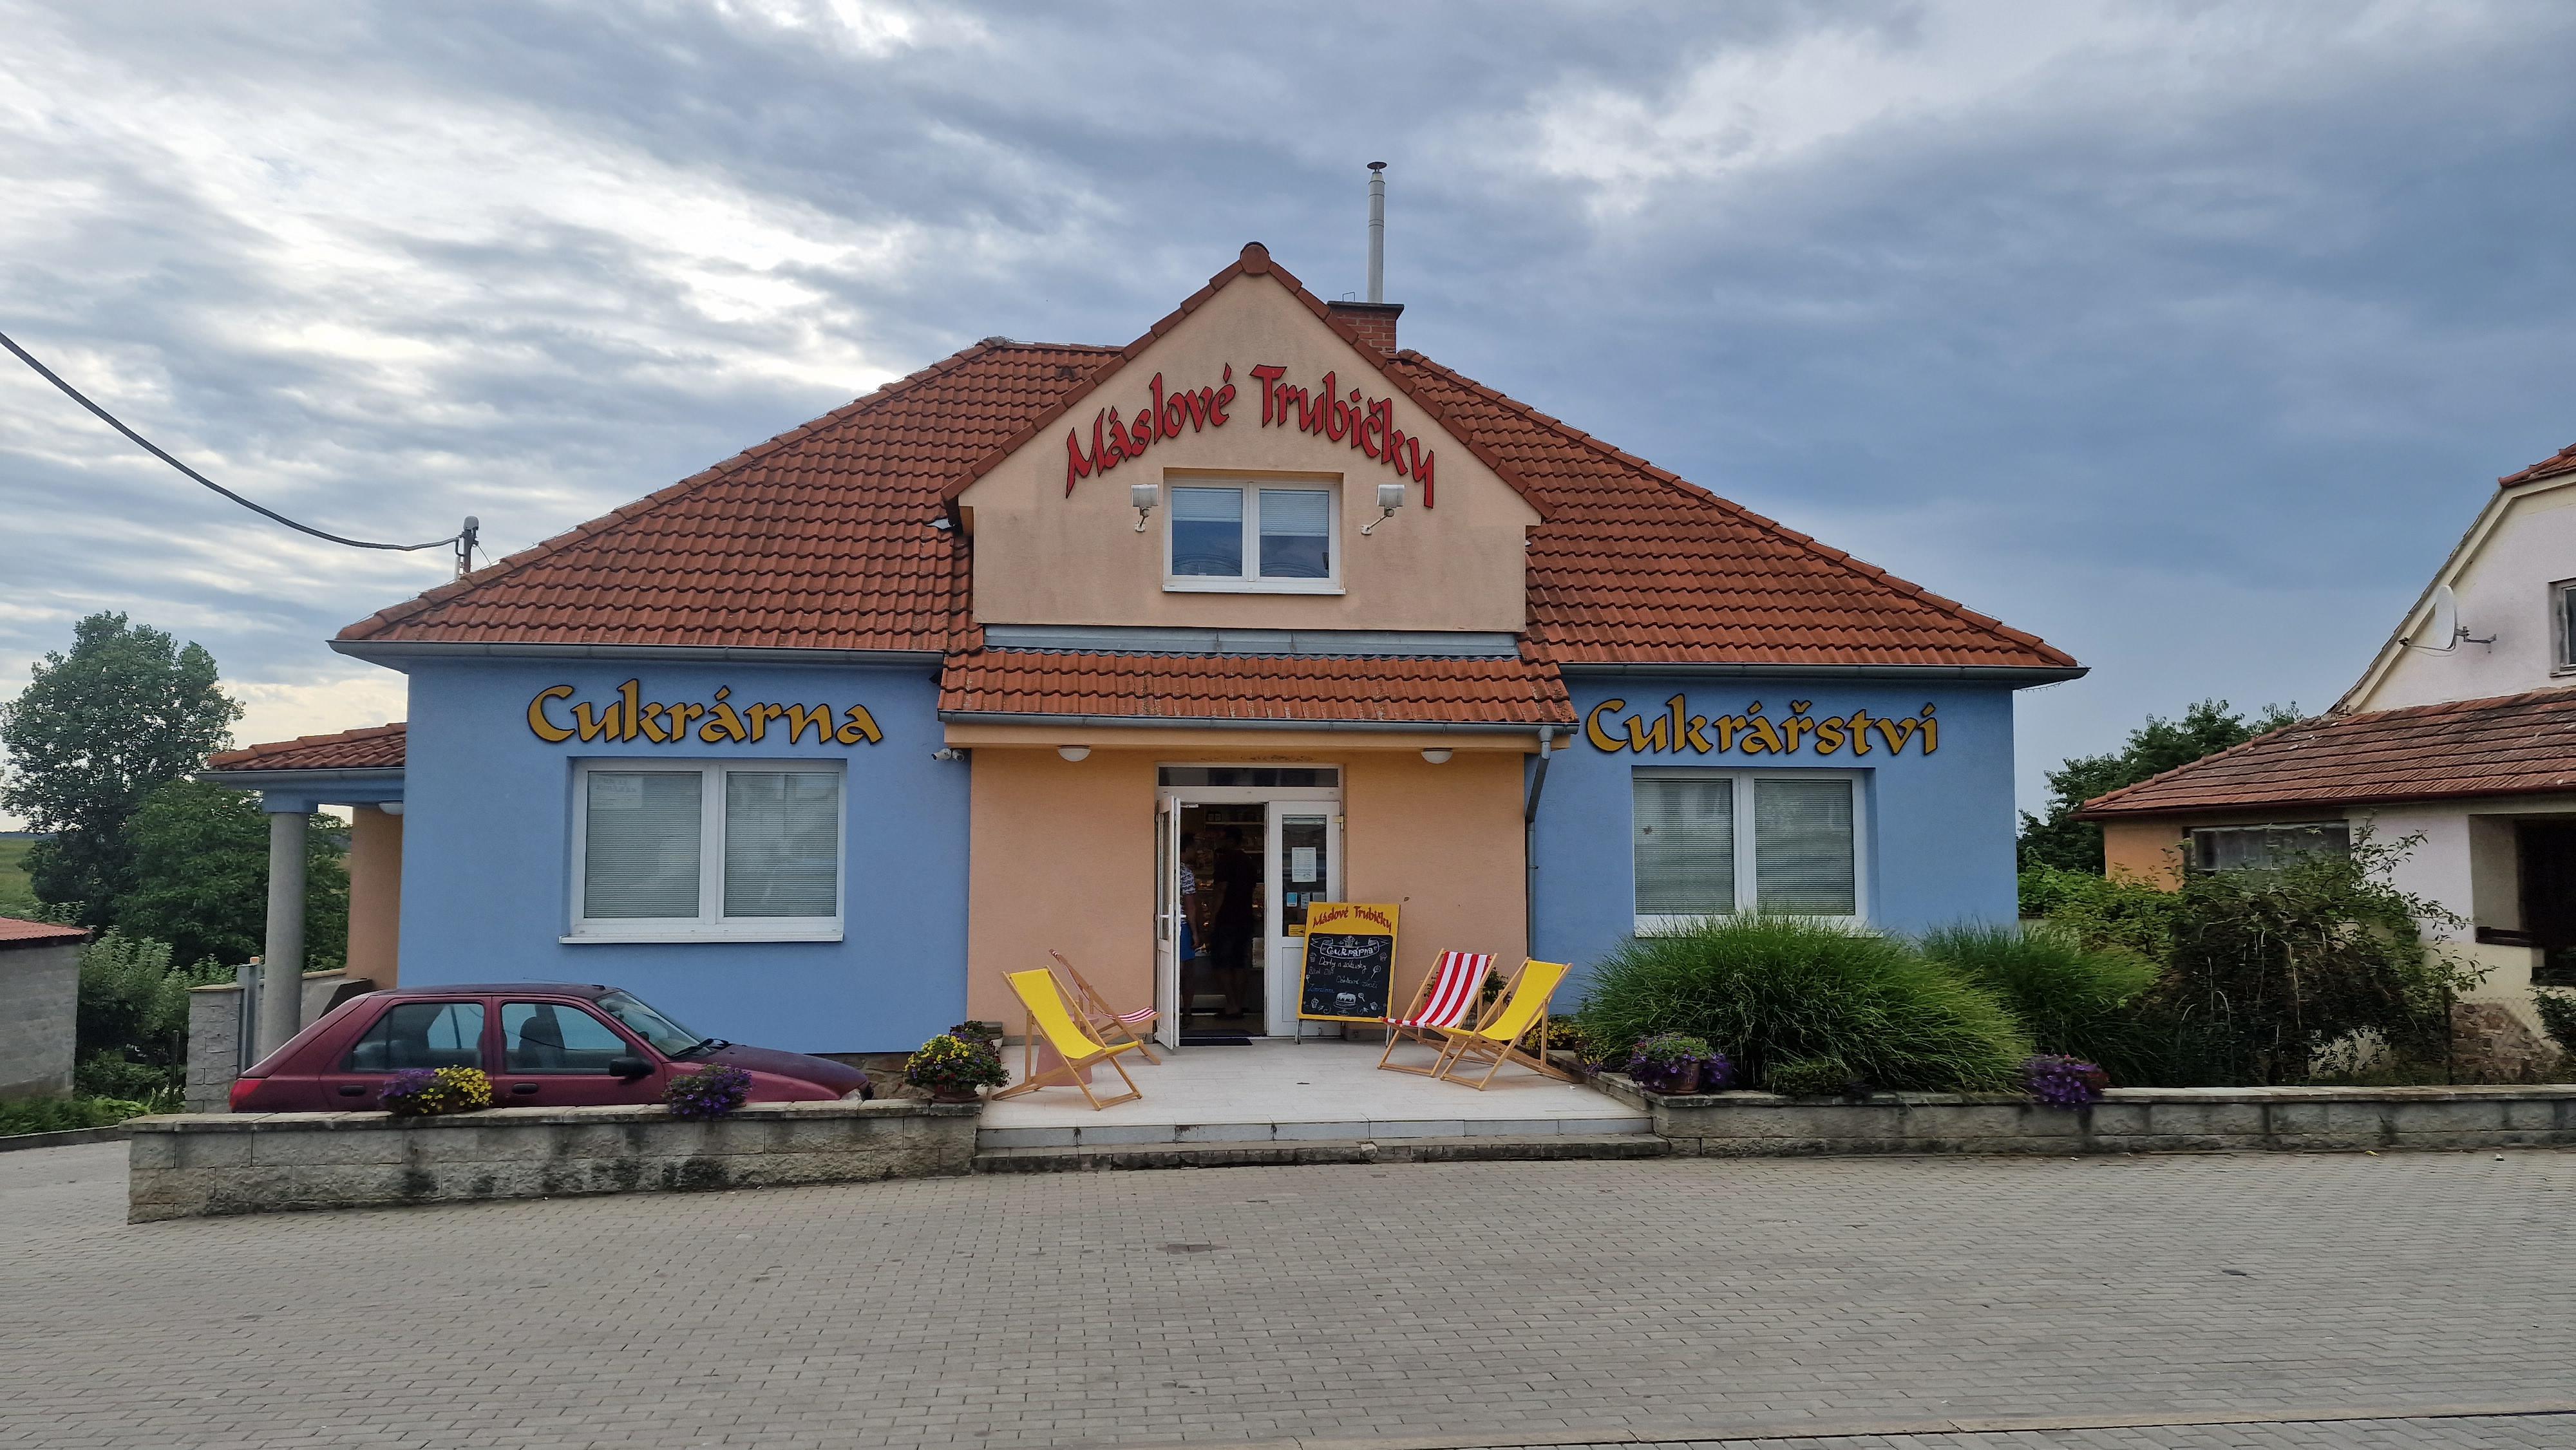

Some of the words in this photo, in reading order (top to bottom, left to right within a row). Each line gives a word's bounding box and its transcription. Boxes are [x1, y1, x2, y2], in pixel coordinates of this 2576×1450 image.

[1066, 362, 1236, 498] Máslové
[1249, 364, 1434, 509] Trubičky
[527, 678, 884, 745] Cukrárna
[1586, 693, 1938, 755] Cukrářství
[1312, 906, 1349, 928] Máslové
[1353, 905, 1392, 933] Trubičky
